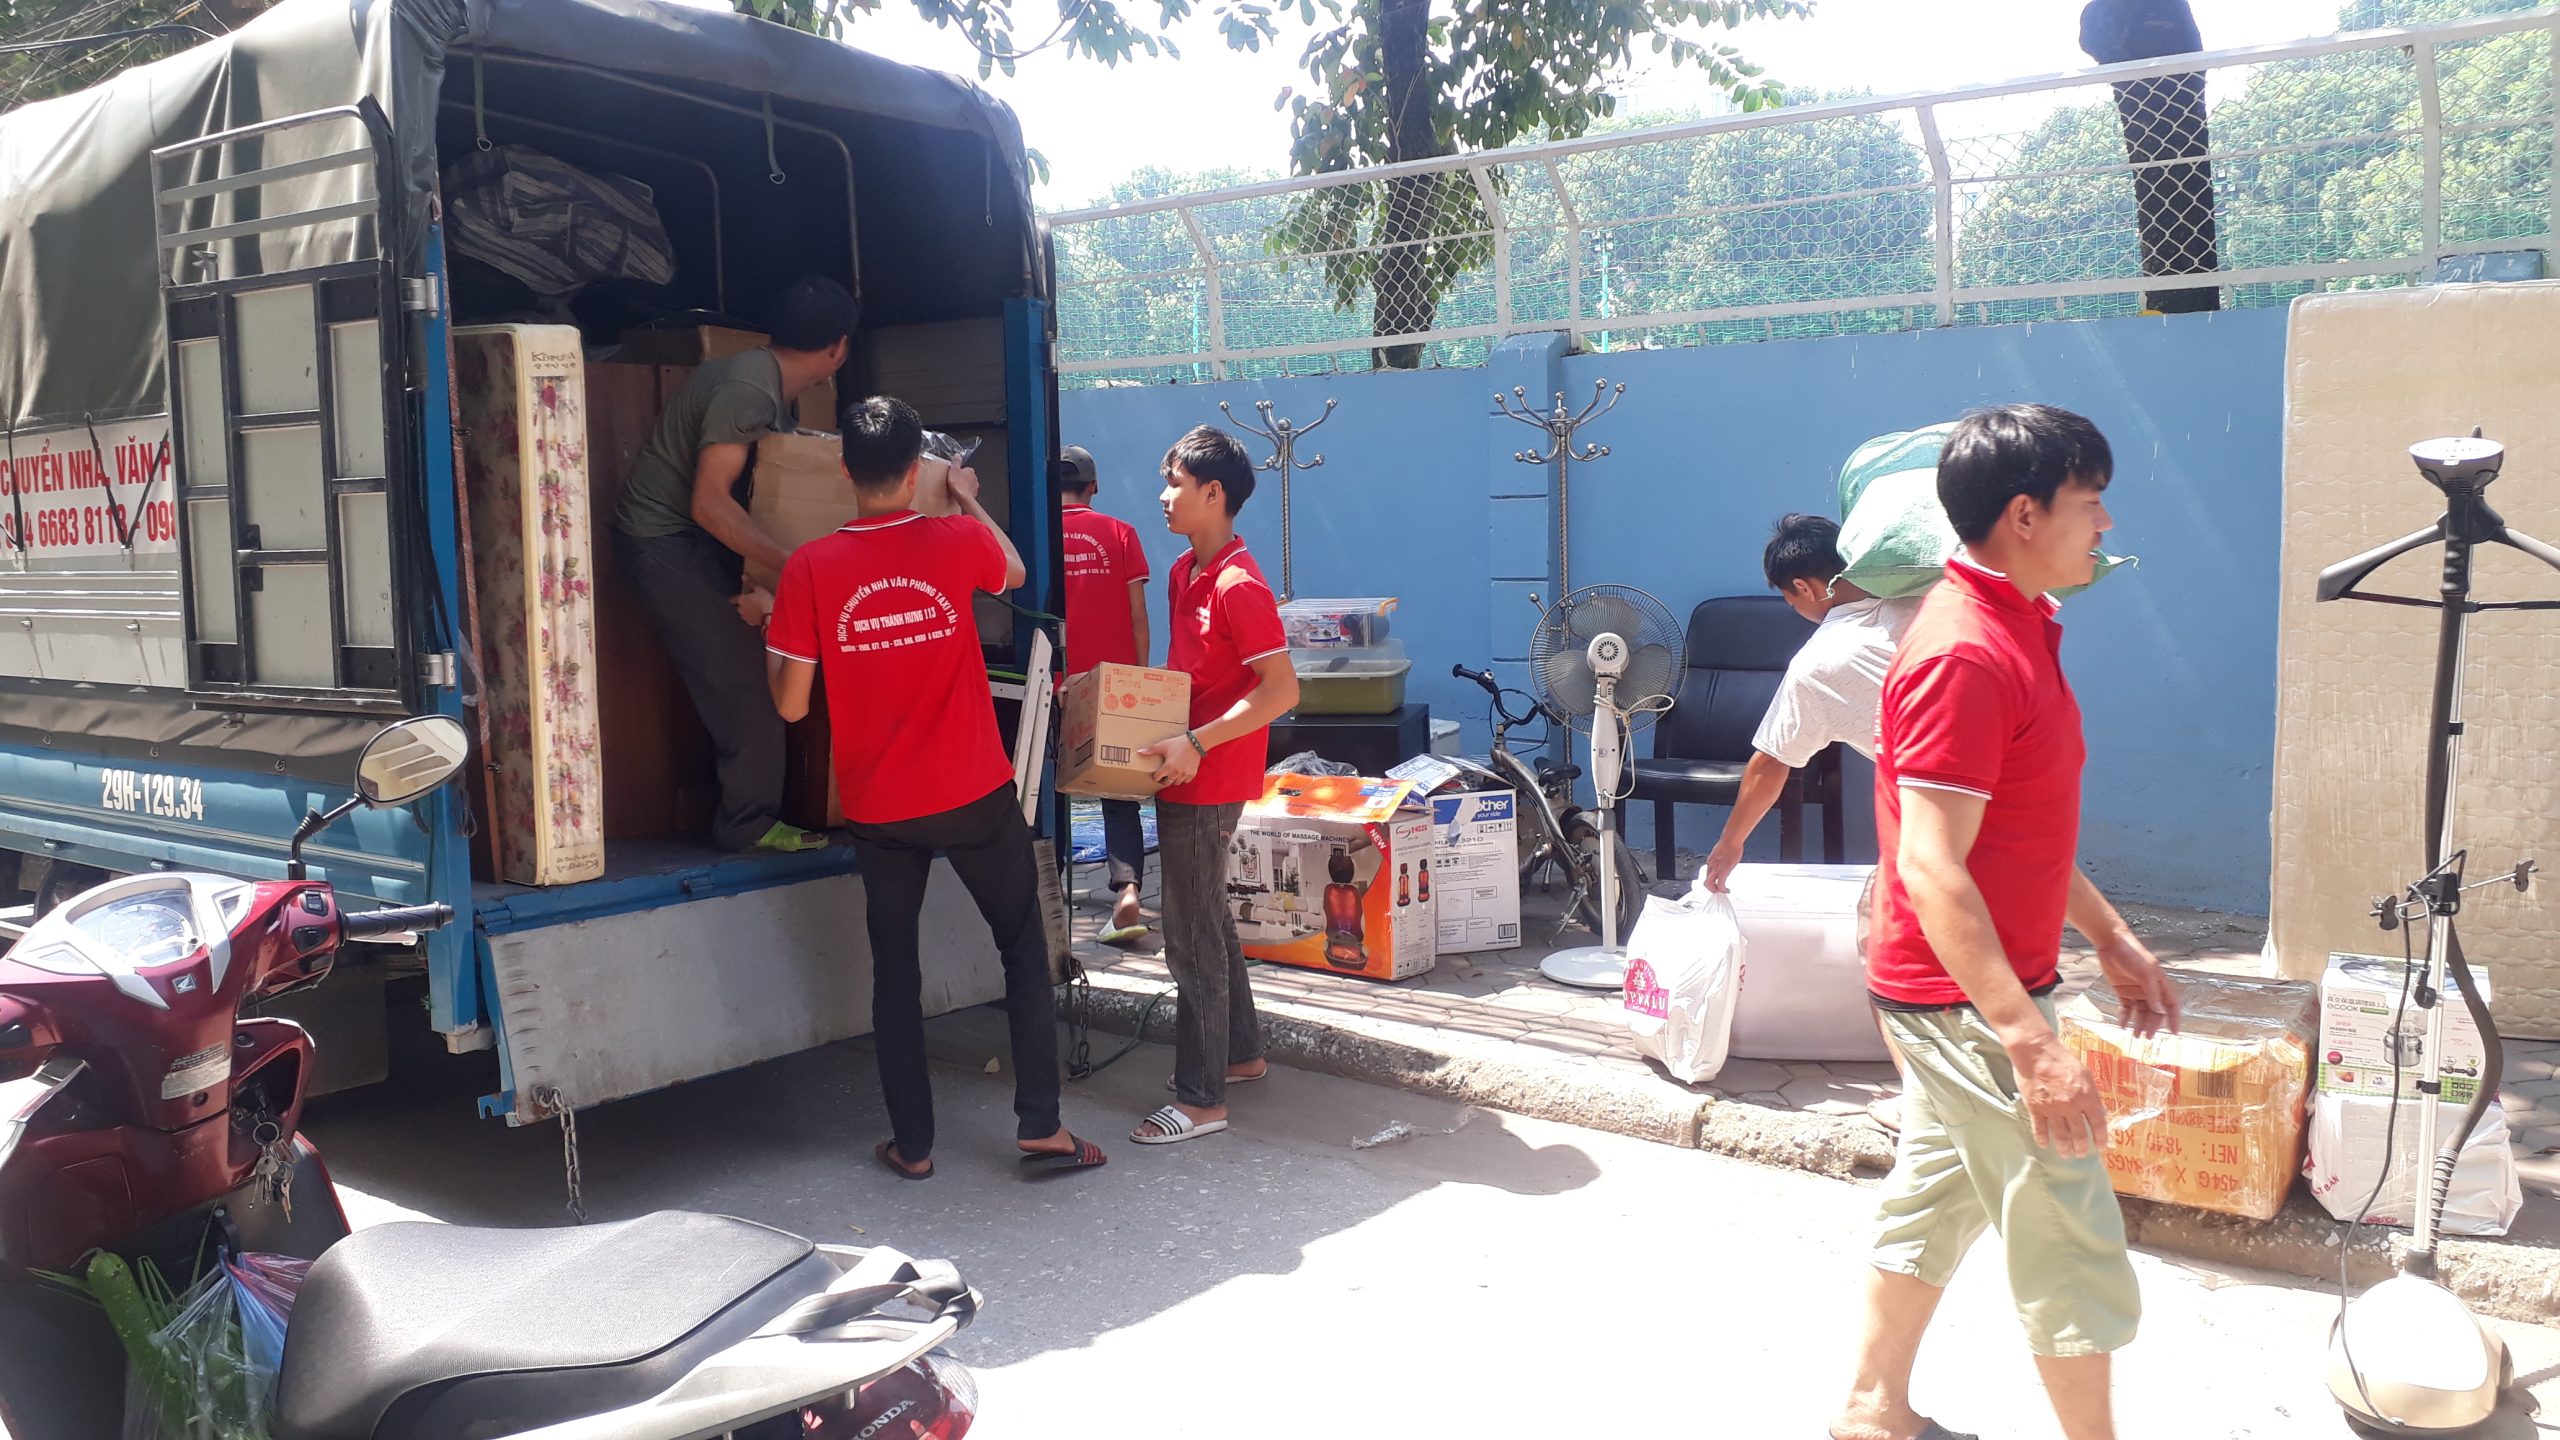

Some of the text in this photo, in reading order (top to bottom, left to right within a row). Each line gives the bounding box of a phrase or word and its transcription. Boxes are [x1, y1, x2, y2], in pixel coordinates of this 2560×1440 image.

[115, 435, 154, 486] VĂN
[5, 510, 34, 550] 04
[38, 506, 79, 547] 6683
[935, 592, 951, 609] TAXI
[102, 768, 204, 821] 29H-129.34
[1262, 830, 1282, 838] WORLD
[1292, 833, 1320, 841] MASSAGE
[1370, 829, 1386, 849] NEW
[2176, 1165, 2187, 1184] X
[2200, 1170, 2238, 1192] 454G
